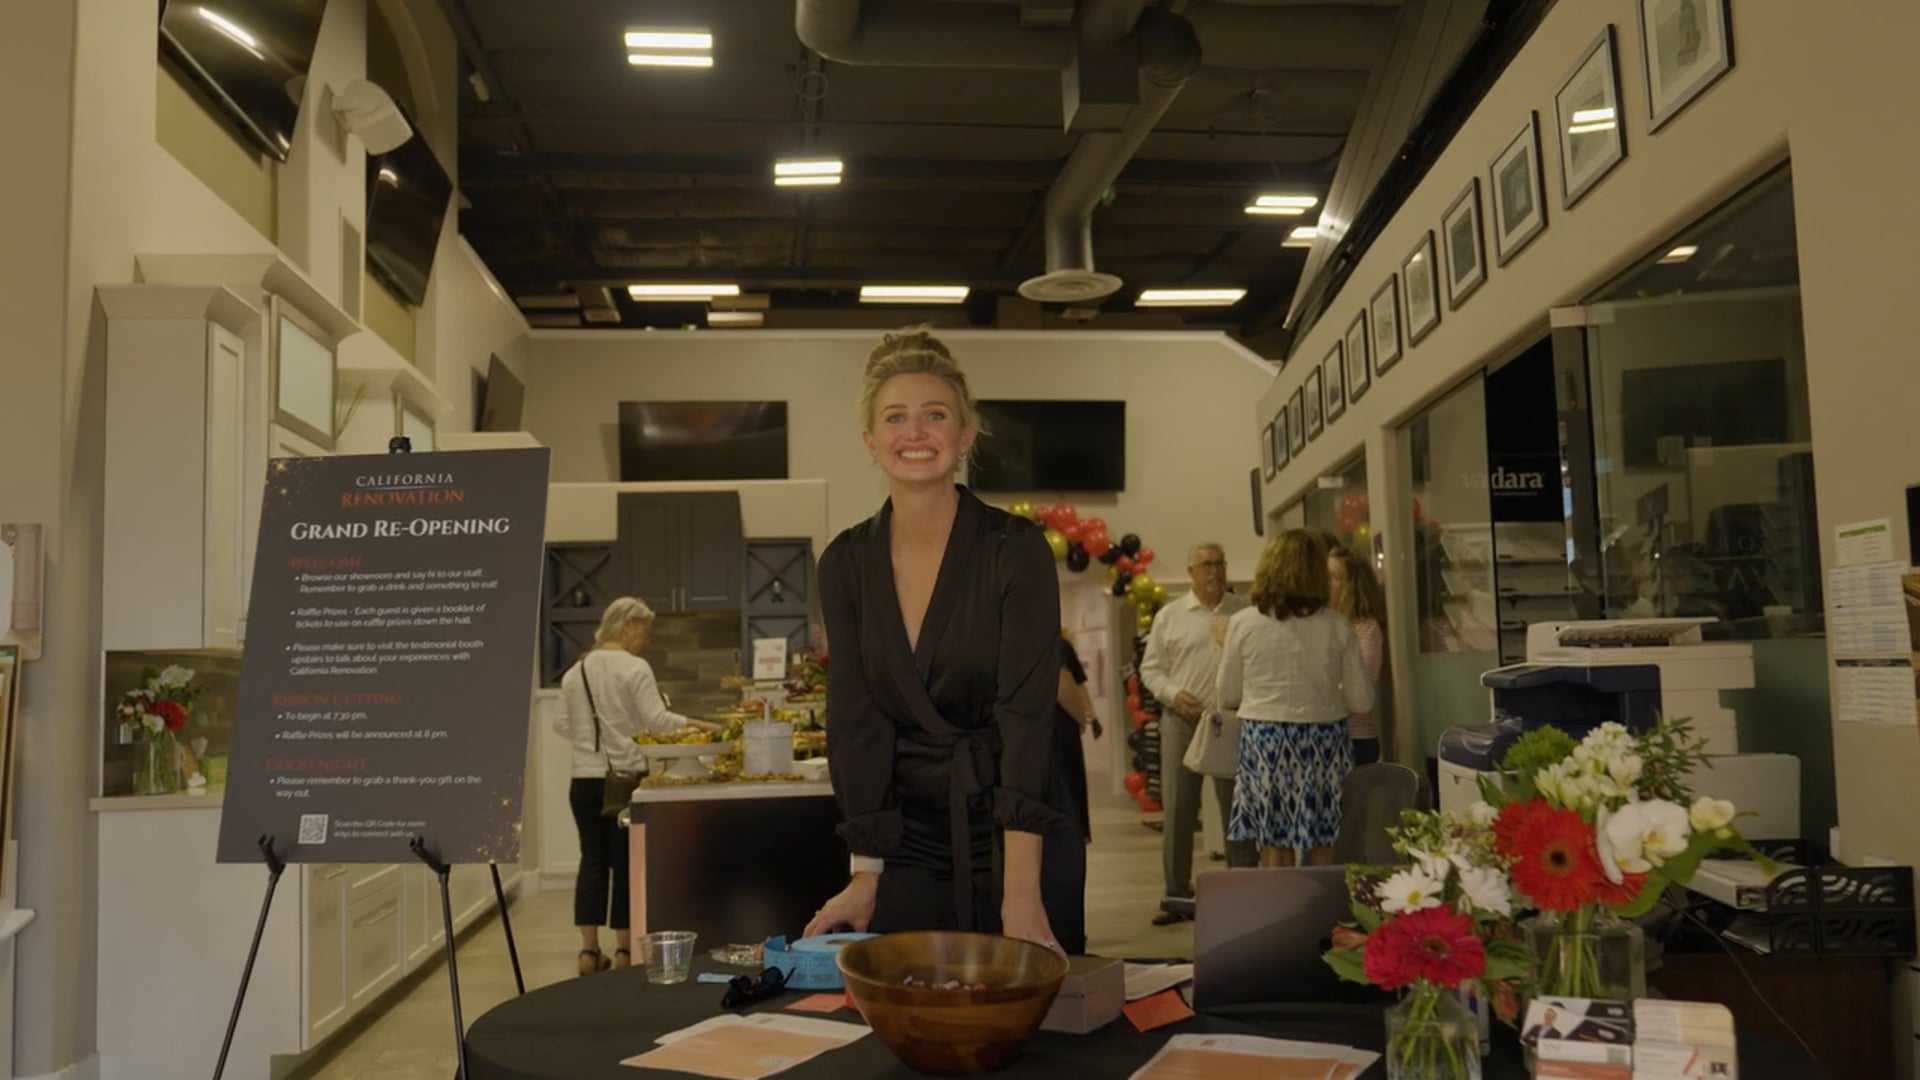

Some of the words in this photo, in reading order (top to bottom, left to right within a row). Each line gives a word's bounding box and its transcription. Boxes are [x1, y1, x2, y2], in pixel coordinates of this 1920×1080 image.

[356, 472, 453, 487] CALIFORNIA
[342, 488, 464, 506] RENOVATION
[290, 522, 368, 540] GRAND
[290, 555, 362, 569] WELCOME
[301, 573, 332, 582] Browse
[349, 572, 392, 581] showroom
[394, 571, 411, 580] and
[412, 571, 426, 580] say
[427, 570, 436, 578] hi
[437, 570, 446, 578] to
[300, 584, 346, 593] Remember
[347, 584, 356, 592] to
[357, 584, 377, 593] grab
[385, 583, 406, 591] drink
[407, 582, 424, 591] and
[425, 581, 469, 591] something
[470, 580, 480, 588] to
[297, 607, 322, 616] Raffle
[323, 607, 348, 616] Prizes
[354, 606, 376, 615] Each
[376, 607, 400, 616] guest
[402, 606, 409, 614] is
[410, 605, 434, 616] given
[442, 604, 475, 613] booklet
[475, 602, 486, 612] of
[295, 619, 322, 628] tickets
[324, 619, 334, 628] to
[363, 618, 386, 627] raffle
[386, 619, 411, 627] prizes
[412, 617, 438, 625] down
[439, 616, 453, 624] the
[292, 642, 321, 652] Please
[321, 642, 345, 651] make
[346, 643, 365, 651] sure
[366, 642, 377, 650] to
[377, 641, 394, 650] visit
[394, 641, 410, 650] the
[410, 640, 458, 649] testimonial
[458, 639, 484, 648] booth
[291, 655, 324, 664] upstairs
[325, 655, 335, 663] to
[335, 654, 351, 662] talk
[352, 654, 377, 662] about
[378, 654, 398, 664] your
[398, 653, 451, 663] experiences
[452, 651, 471, 661] with
[289, 667, 329, 675] California
[273, 692, 328, 707] RIBBON
[330, 690, 402, 705] CUTTING
[285, 711, 297, 720] To
[297, 711, 322, 722] begin
[322, 711, 332, 719] at
[282, 730, 308, 739] Raffle
[308, 730, 334, 739] Prizes
[335, 730, 350, 739] will
[351, 730, 363, 739] be
[364, 729, 413, 739] announced
[413, 729, 423, 738] at
[424, 729, 430, 738] 8
[266, 757, 312, 773] GOOD
[318, 756, 368, 771] NIGHT
[276, 776, 306, 785] Please
[306, 776, 352, 785] remember
[352, 776, 363, 785] to
[363, 775, 384, 787] grab
[392, 775, 438, 786] thank-you
[438, 774, 453, 786] gift
[453, 776, 466, 784] on
[466, 775, 482, 784] the
[275, 789, 294, 800] way
[334, 819, 352, 829] Scan
[352, 819, 364, 828] the
[365, 819, 377, 829] QR
[377, 819, 396, 828] Code
[396, 819, 407, 828] for
[407, 819, 427, 828] more
[333, 830, 352, 840] ways
[361, 830, 389, 838] connect
[390, 829, 405, 838] with
